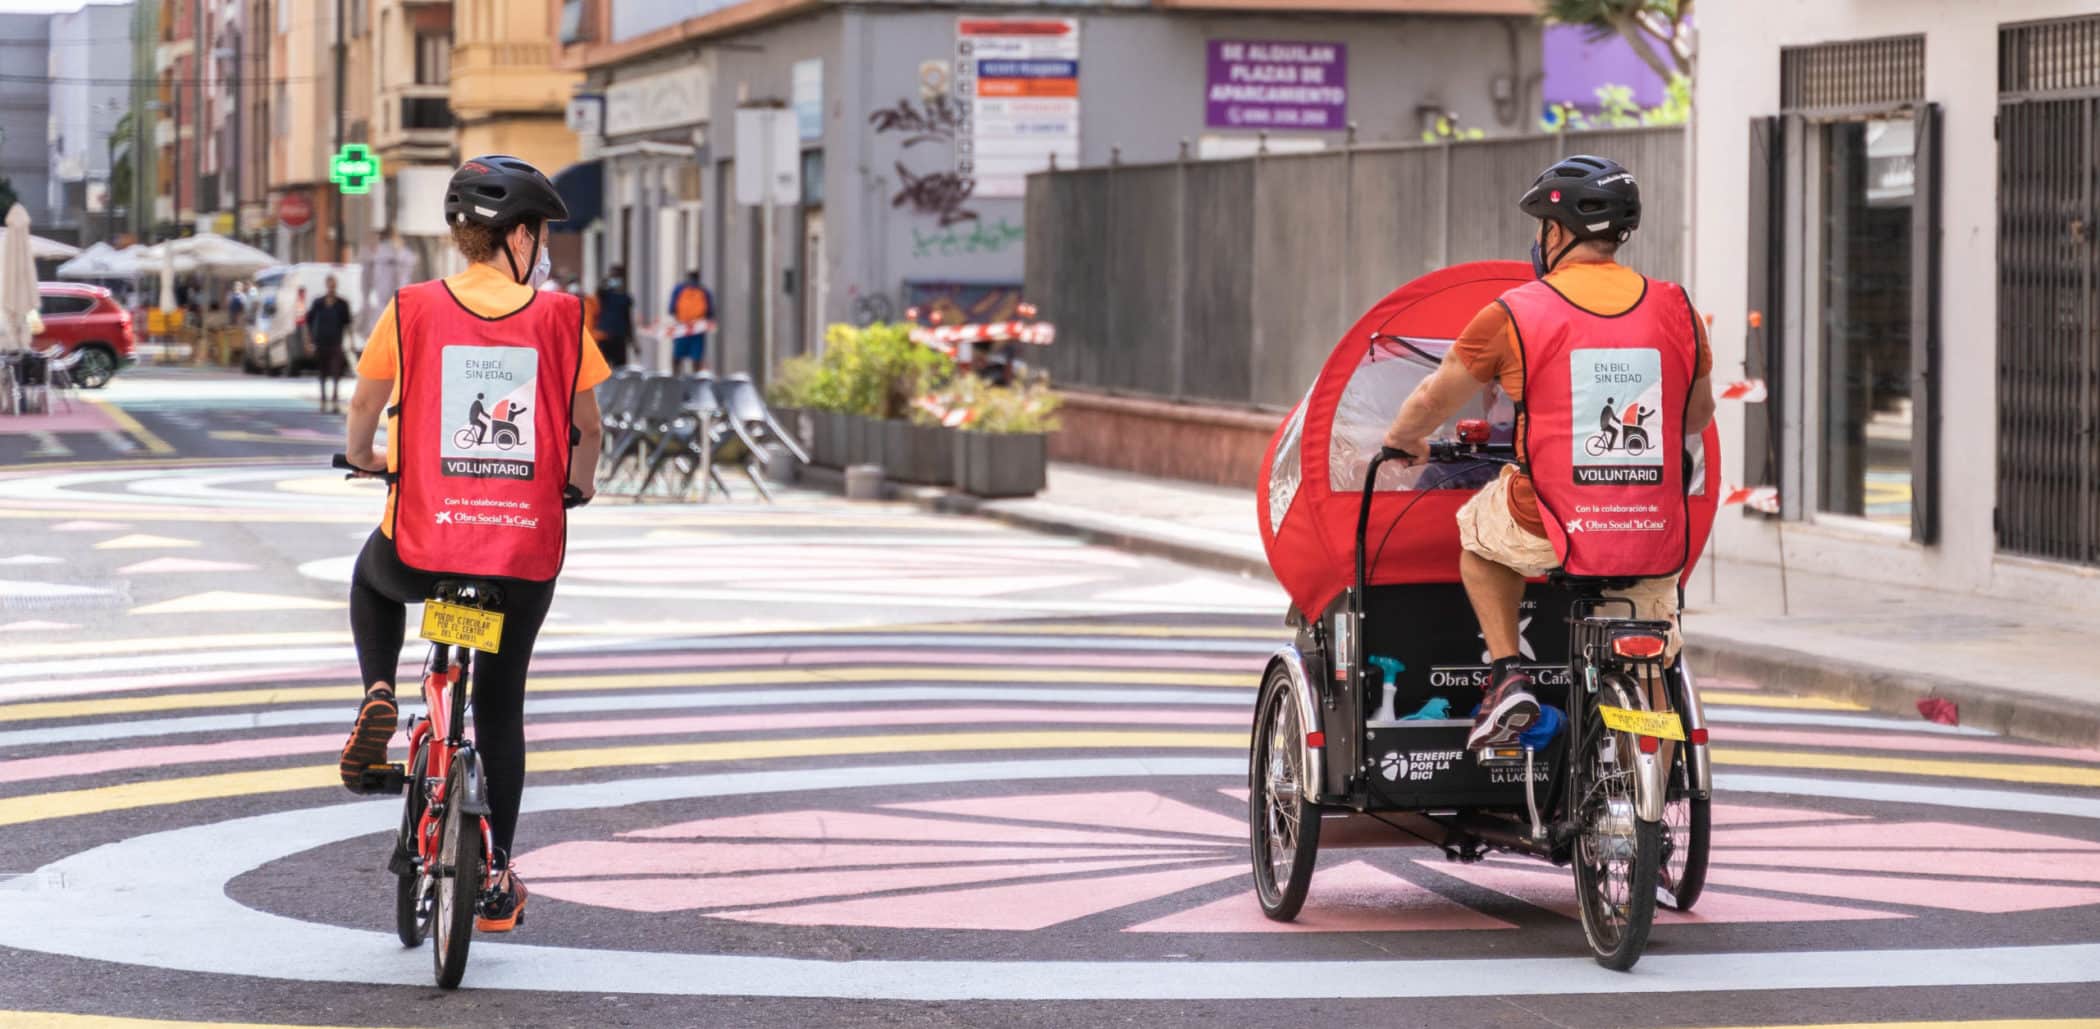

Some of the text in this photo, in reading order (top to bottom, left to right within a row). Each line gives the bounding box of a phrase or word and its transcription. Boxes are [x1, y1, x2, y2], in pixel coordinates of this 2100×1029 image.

[1221, 44, 1336, 63] SE ALQUILAN
[1230, 64, 1325, 84] PLAZAS DE
[1210, 84, 1345, 104] APARCAMIENTO
[466, 360, 502, 370] EN BICI
[1594, 363, 1630, 372] EN BICI
[466, 370, 512, 381] SIN EDAD
[1595, 374, 1642, 383] SIN EDAD
[447, 461, 529, 476] VOLUNTARIO
[1578, 469, 1658, 481] VOLUNTARIO
[470, 498, 518, 508] colaboración
[1576, 504, 1590, 512] Con
[1593, 504, 1600, 512] la
[1601, 504, 1647, 512] colaboración
[454, 512, 476, 522] Obra
[478, 513, 502, 523] Social
[1586, 520, 1608, 529] Obra
[1609, 520, 1632, 529] Social
[1430, 671, 1469, 686] Obra
[1538, 670, 1572, 685] Caix
[1409, 751, 1463, 761] TENERIFE
[1410, 761, 1450, 770] POR LA
[1410, 771, 1433, 780] BICI
[1491, 772, 1550, 783] LA LAGNA
